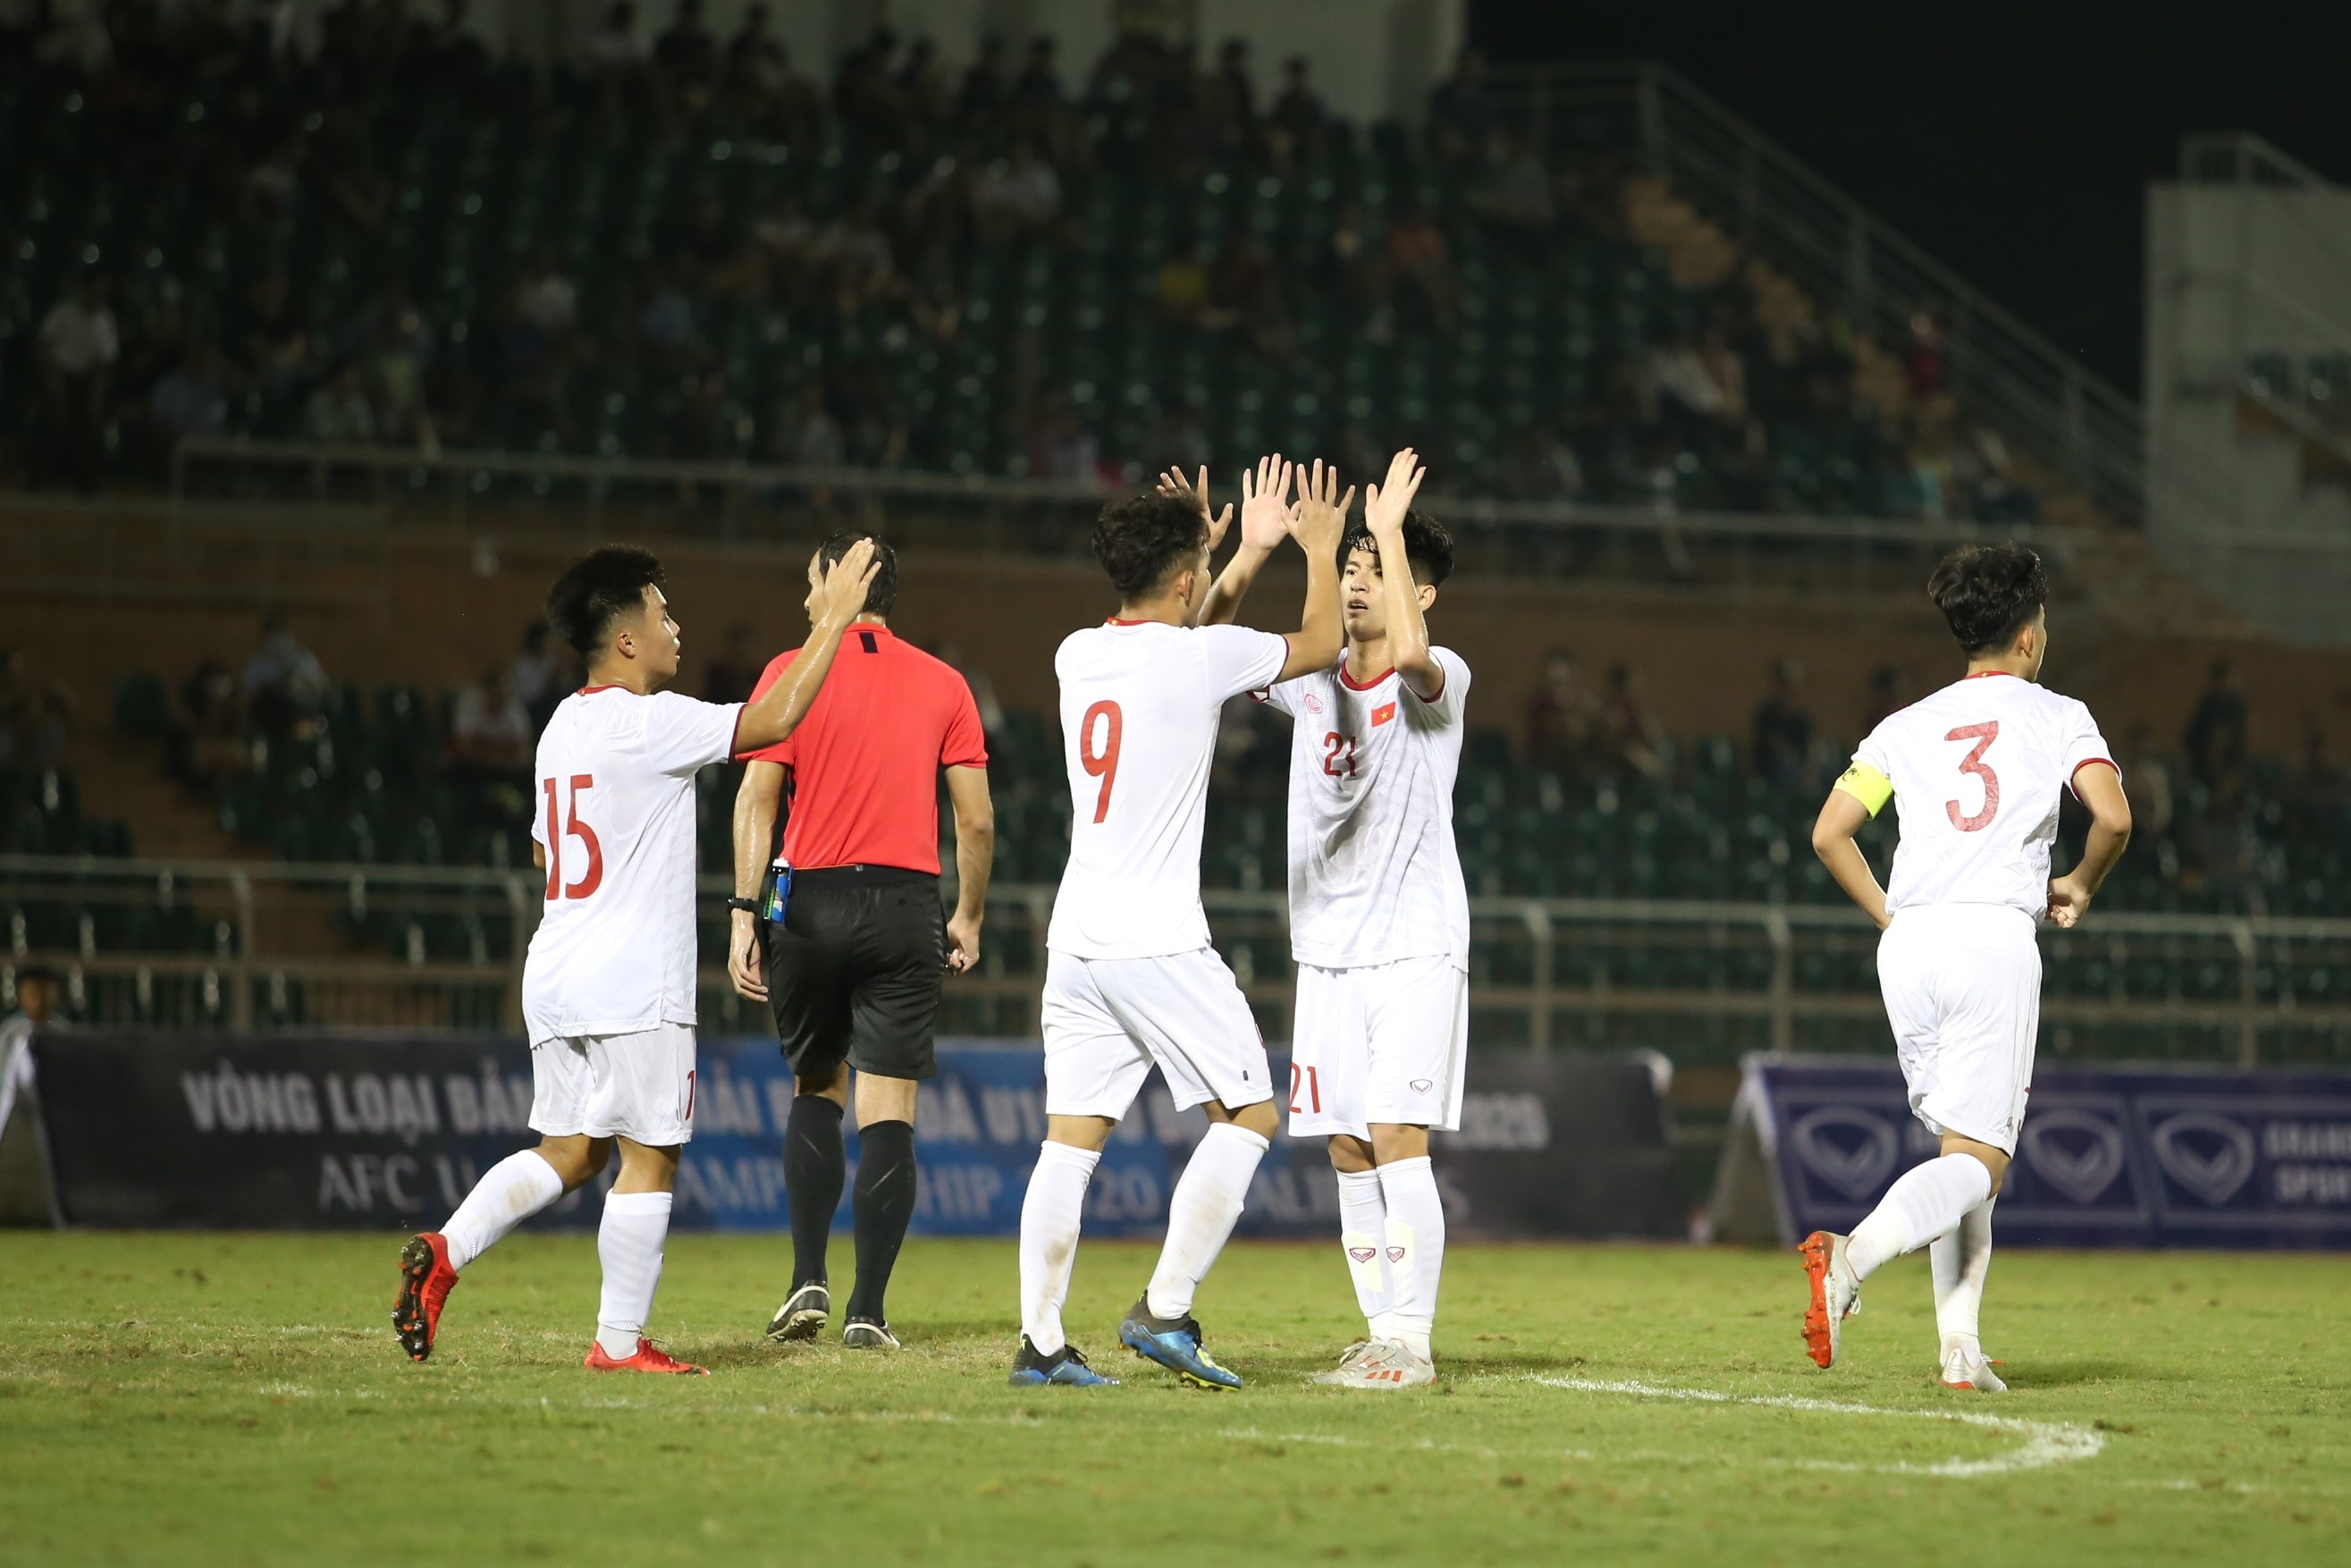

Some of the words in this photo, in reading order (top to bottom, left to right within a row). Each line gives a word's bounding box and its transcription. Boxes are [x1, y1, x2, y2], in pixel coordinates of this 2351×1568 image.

[1080, 700, 1123, 824] 9
[1324, 731, 1357, 777] 21
[1944, 721, 2000, 832] 3
[544, 773, 603, 900] 15
[183, 1058, 321, 1134] VÒNG
[325, 1074, 441, 1146] LOẠI
[445, 1058, 535, 1135] BẢN
[1289, 1061, 1320, 1114] 21
[316, 1153, 425, 1215] AFC
